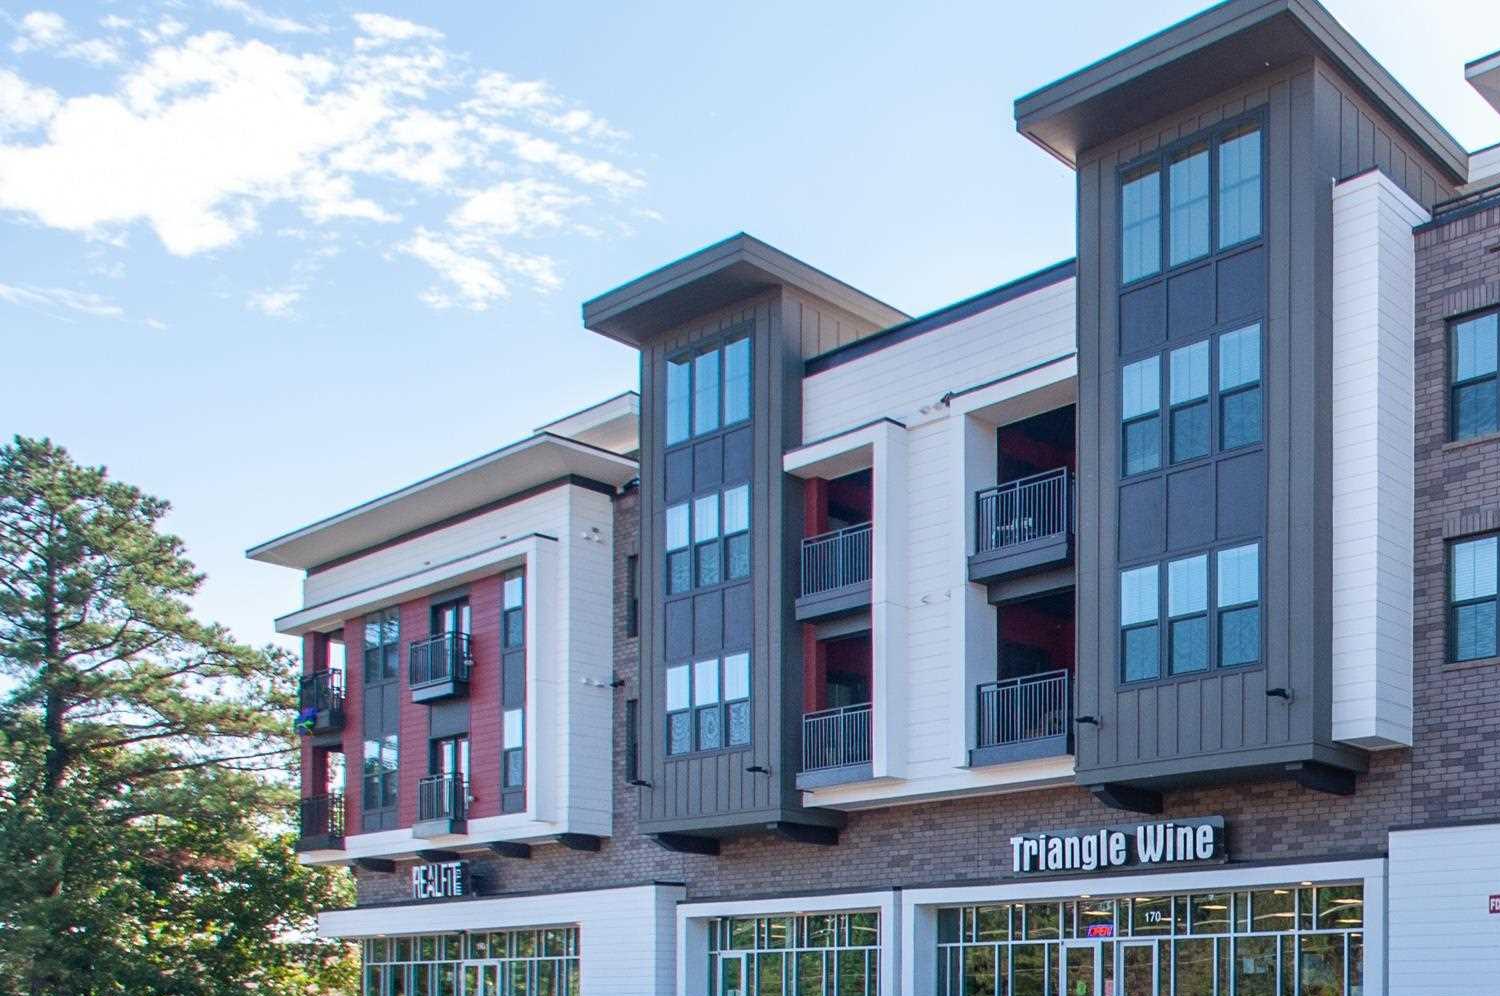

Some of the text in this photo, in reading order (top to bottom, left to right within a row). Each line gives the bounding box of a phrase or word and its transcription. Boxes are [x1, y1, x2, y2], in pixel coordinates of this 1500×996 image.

[1010, 823, 1214, 872] Triangle Wine
[1145, 911, 1161, 922] 170
